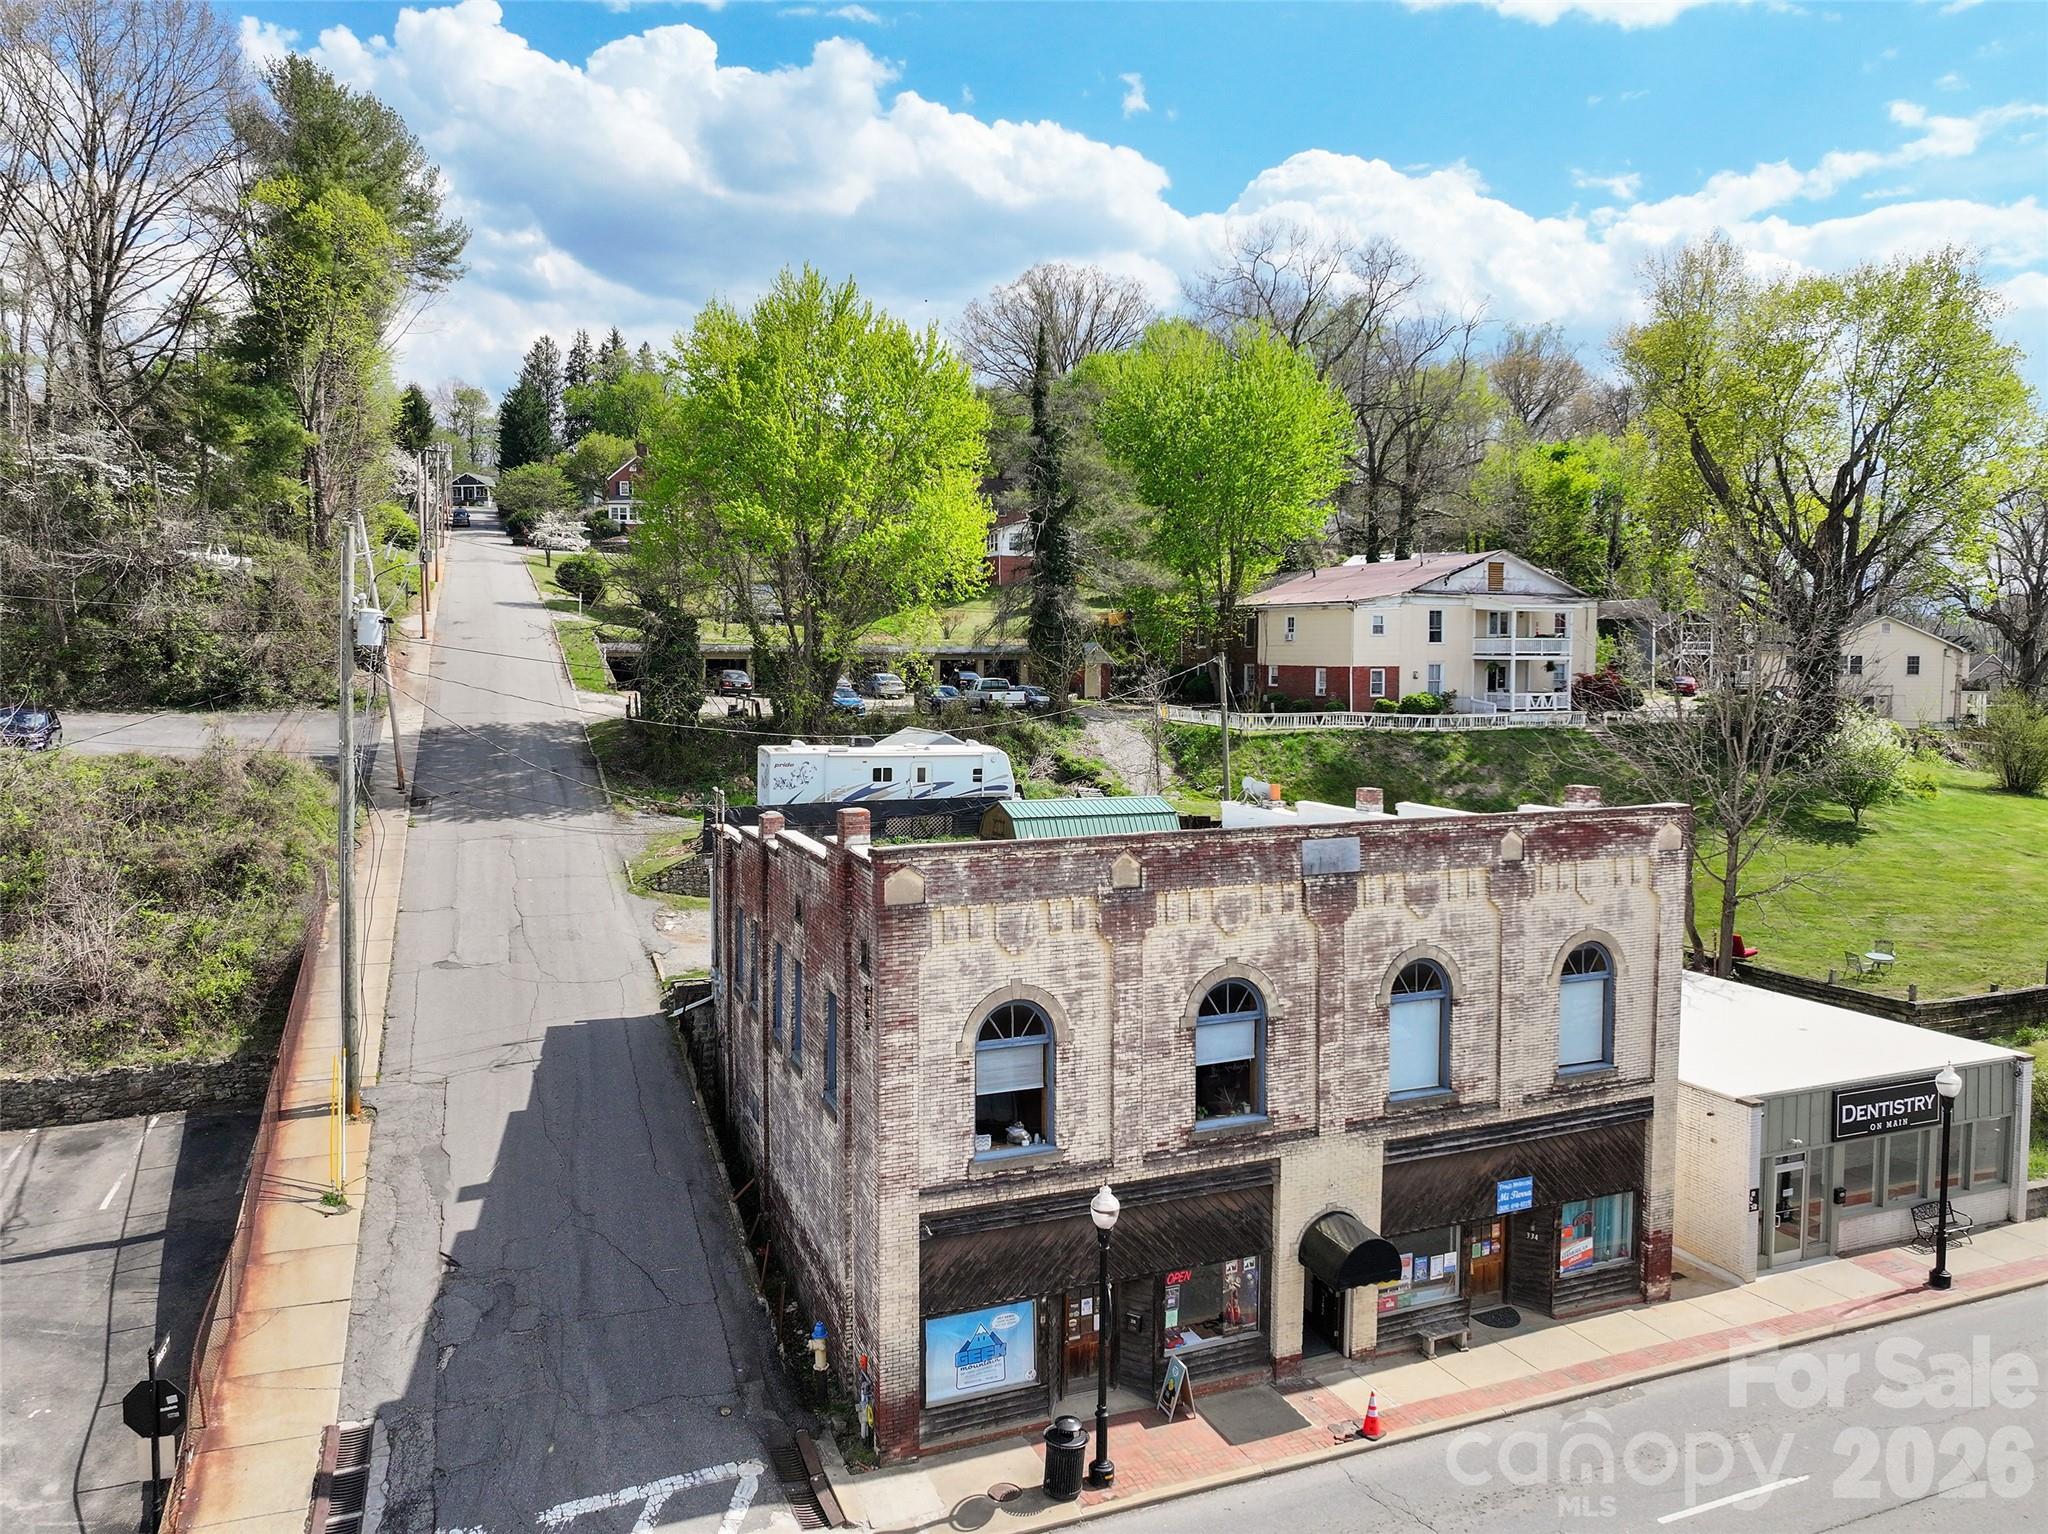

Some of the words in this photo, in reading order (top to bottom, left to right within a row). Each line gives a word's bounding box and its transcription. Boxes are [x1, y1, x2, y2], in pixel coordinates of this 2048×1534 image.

[1841, 1094, 1936, 1124] DENTISTRY
[1870, 1122, 1882, 1131] ON
[1886, 1118, 1908, 1129] MAIN
[1167, 1270, 1192, 1284] OPEN
[960, 1357, 1002, 1371] mountain
